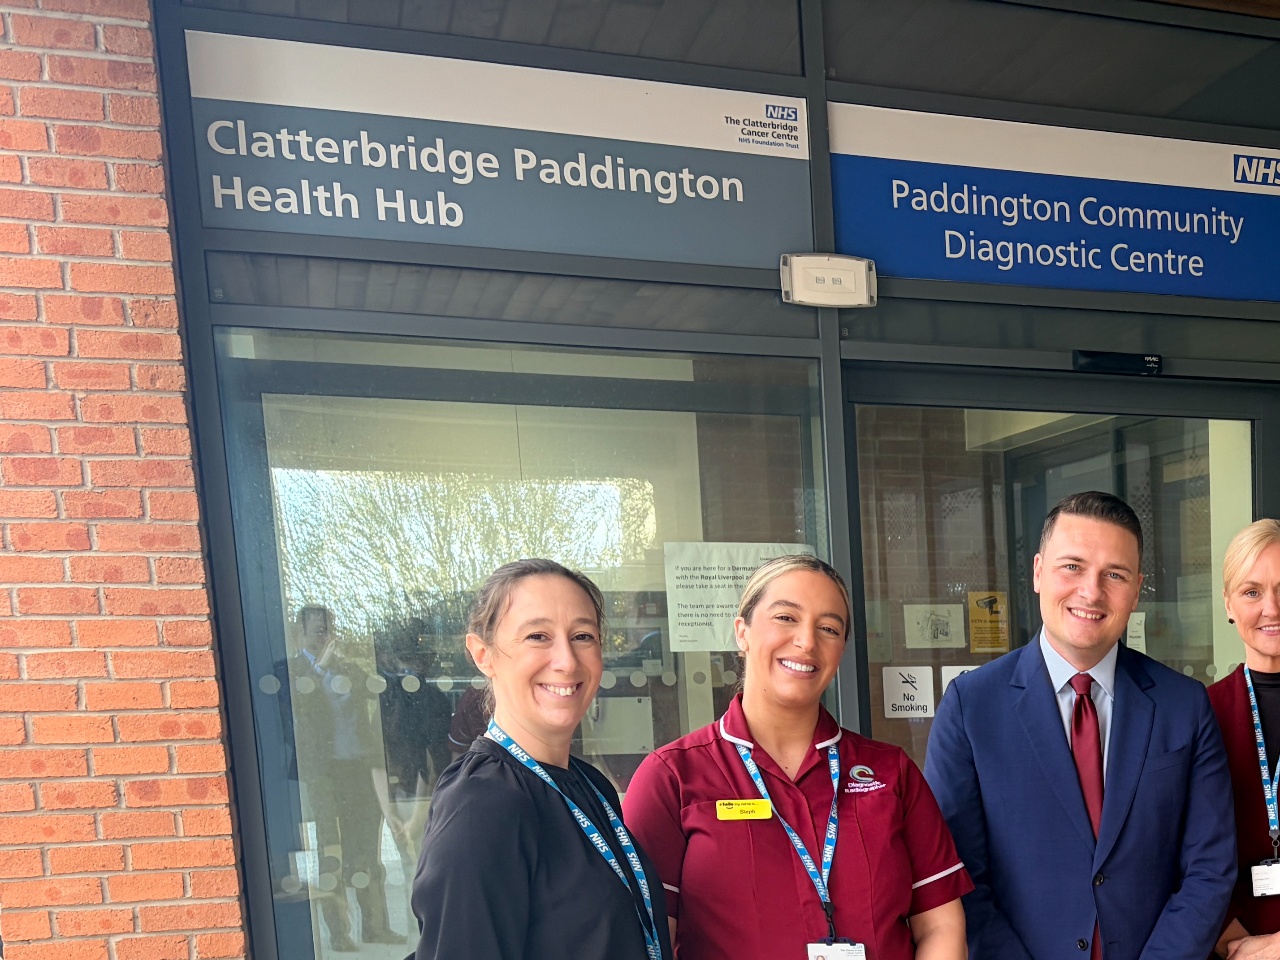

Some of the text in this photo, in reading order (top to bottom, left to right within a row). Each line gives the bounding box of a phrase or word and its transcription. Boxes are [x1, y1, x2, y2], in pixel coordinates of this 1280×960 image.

[767, 105, 796, 119] NHS
[725, 116, 798, 132] The Clatterbridge
[741, 128, 798, 141] Cancer Centre
[206, 119, 744, 204] Clatterbridge Paddington
[212, 174, 464, 227] Health Hub
[891, 179, 1244, 243] Paddington Community
[944, 230, 1204, 277] Diagnostic Centre
[904, 693, 915, 702] No
[891, 704, 928, 713] Smoking
[1254, 728, 1263, 743] NHS
[508, 744, 530, 762] NHS
[1258, 746, 1266, 760] NHS
[532, 766, 553, 782] NHS
[1260, 766, 1269, 780] NHS
[1264, 784, 1272, 798] NHS
[572, 808, 590, 828] NHS
[1268, 804, 1276, 820] NHS
[614, 826, 630, 846] NHS
[828, 822, 836, 840] NHS
[590, 832, 608, 853] NHS
[790, 832, 805, 850] NHS
[627, 852, 642, 872] NHS
[823, 844, 834, 862] NHS
[609, 858, 625, 878] NHS
[802, 854, 816, 872] NHS
[638, 878, 650, 900] NHS
